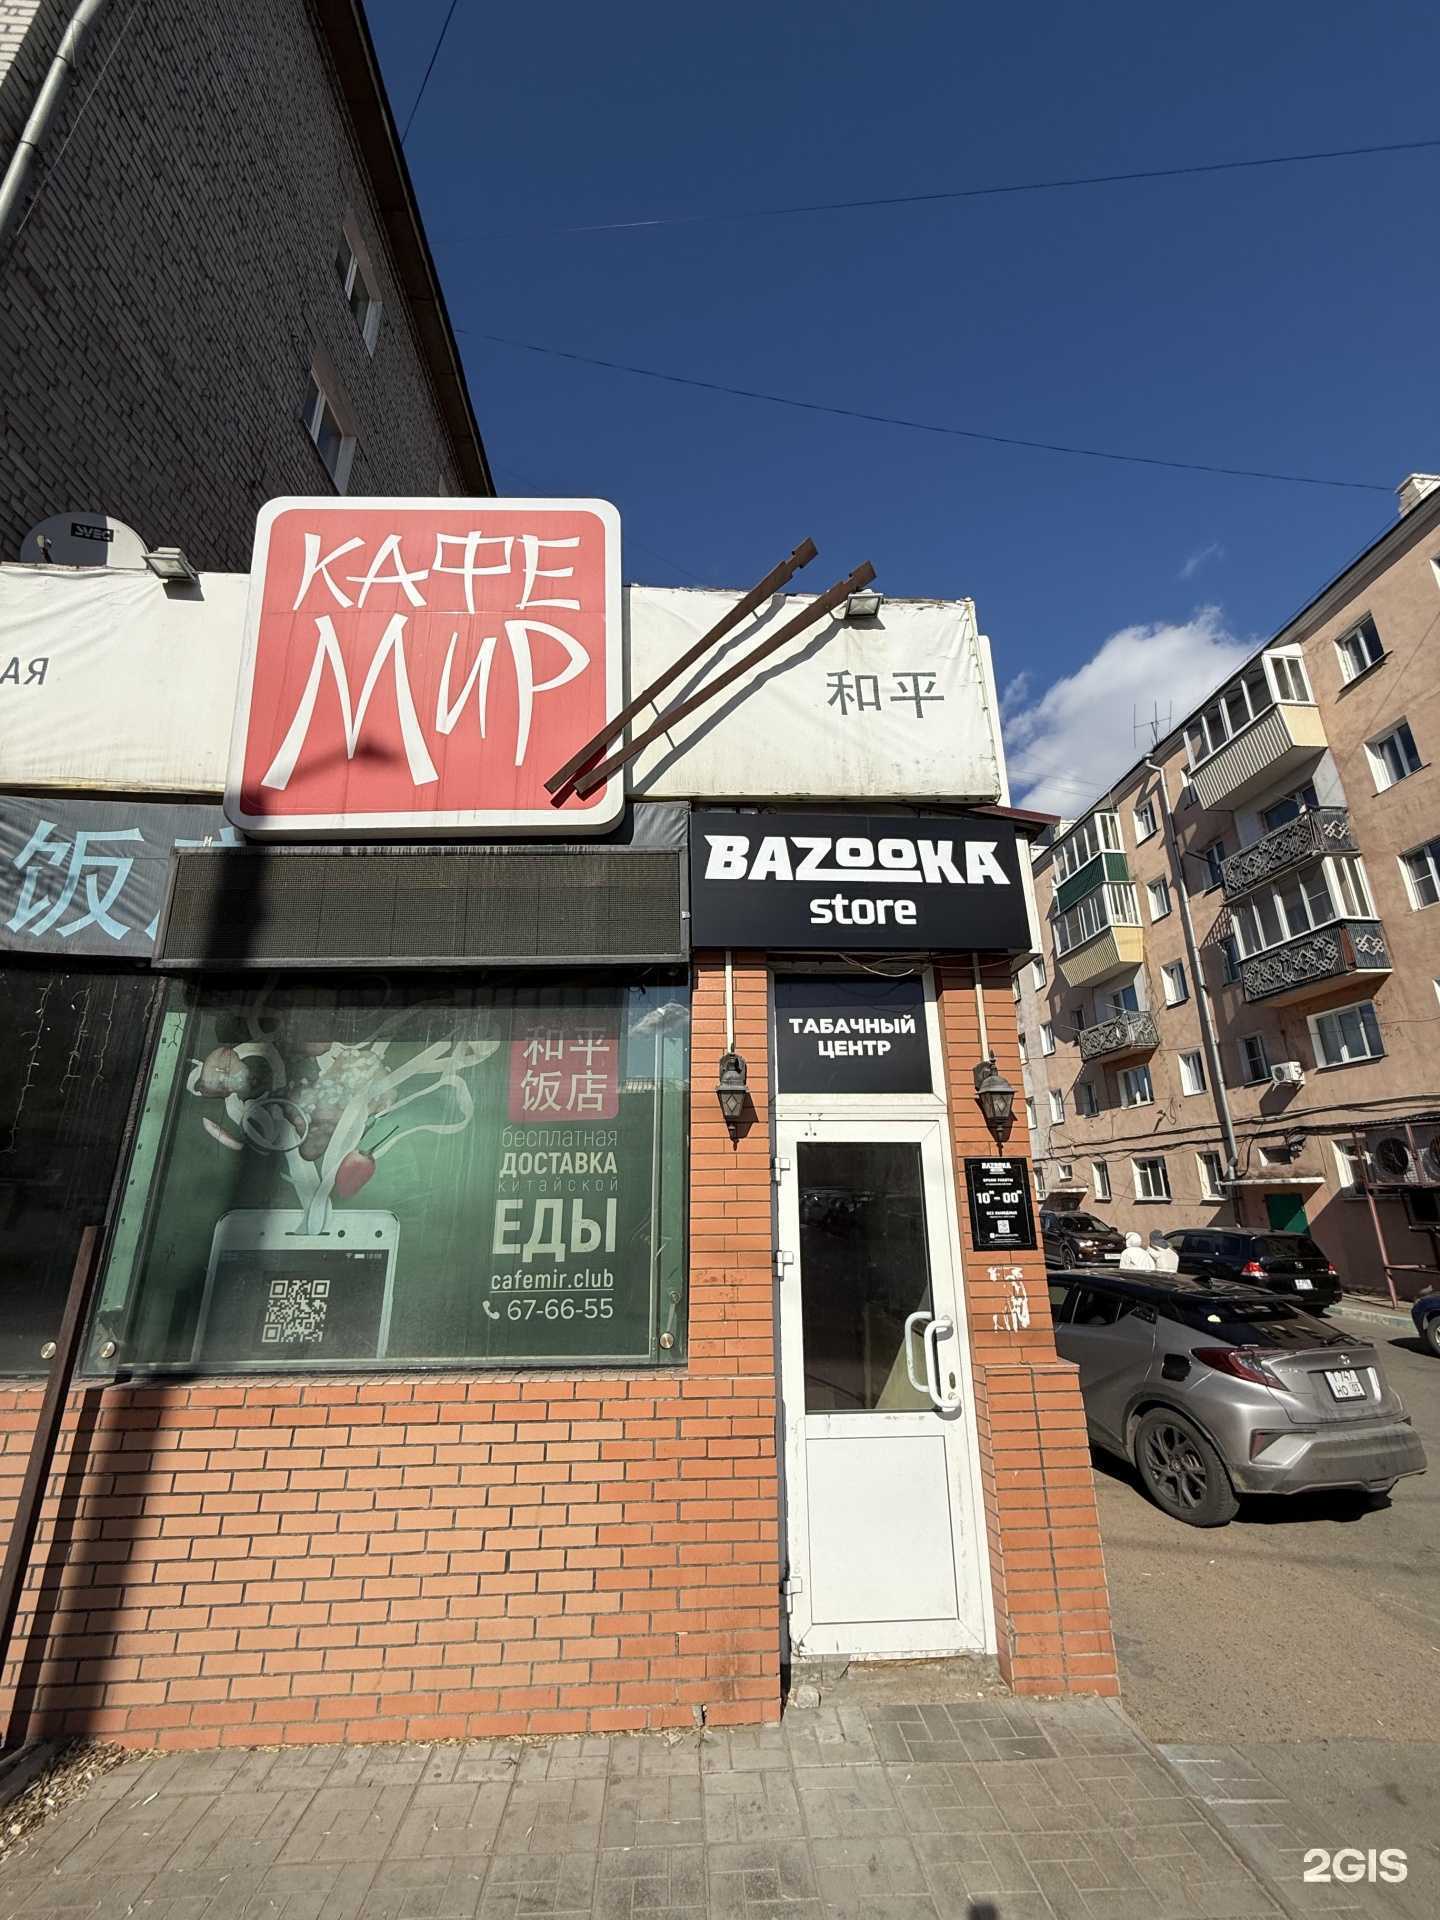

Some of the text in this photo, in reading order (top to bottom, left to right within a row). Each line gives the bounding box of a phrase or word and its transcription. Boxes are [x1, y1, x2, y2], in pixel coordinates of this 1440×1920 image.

[293, 530, 581, 614] КАФЕ
[826, 669, 945, 719] 和平
[704, 834, 1011, 885] BAZOOKA
[810, 893, 917, 925] store
[789, 1015, 916, 1034] ТАБАЧНЫЙ
[522, 1026, 610, 1066] 和平
[818, 1040, 891, 1058] ЦЕНТР
[520, 1069, 608, 1112] 饭店
[502, 1124, 618, 1148] бесплатная
[499, 1151, 618, 1177] ДОСТАВКА
[498, 1176, 618, 1192] китайской
[492, 1198, 617, 1262] ЕДЫ
[491, 1269, 614, 1290] cafemir.club
[507, 1298, 614, 1320] 67-66-55
